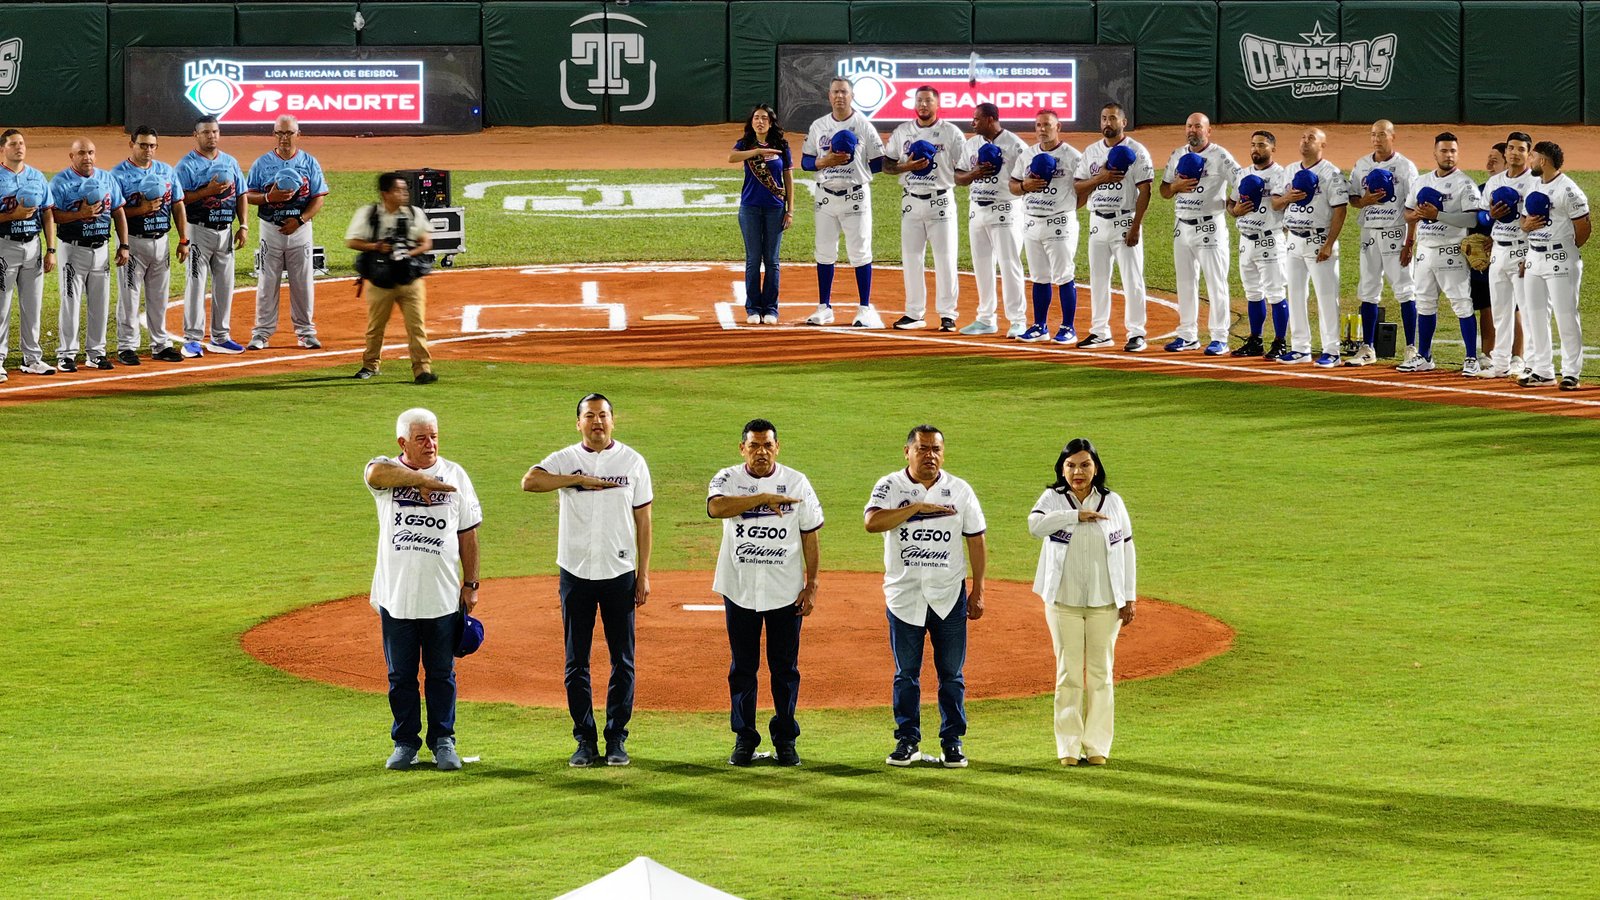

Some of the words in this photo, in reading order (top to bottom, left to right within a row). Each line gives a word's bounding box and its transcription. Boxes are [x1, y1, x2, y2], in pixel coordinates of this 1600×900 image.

[186, 61, 242, 83] LMB
[265, 69, 287, 78] LIGA
[290, 69, 341, 78] MEXICANA
[343, 69, 357, 78] DE
[358, 69, 399, 78] BEISBOL
[917, 67, 941, 76] LIGA
[995, 67, 1009, 76] DE
[1011, 67, 1051, 76] BEISBOL
[1295, 82, 1340, 95] Tabasco
[287, 94, 415, 111] BANORTE
[940, 92, 1068, 108] BANORTE
[992, 203, 1011, 213] PGB
[1047, 216, 1067, 226] PGB
[1195, 223, 1216, 234] PGB
[1381, 230, 1402, 240] PGB
[1254, 238, 1275, 249] PGB
[1439, 246, 1460, 256] PGB
[1545, 252, 1567, 262] PGB
[405, 514, 447, 530] G500
[392, 529, 445, 548] Caliente
[747, 526, 787, 540] G500
[912, 528, 951, 543] G500
[736, 542, 788, 558] Caliente
[900, 545, 951, 560] Caliente
[745, 557, 784, 565] caliente.mx
